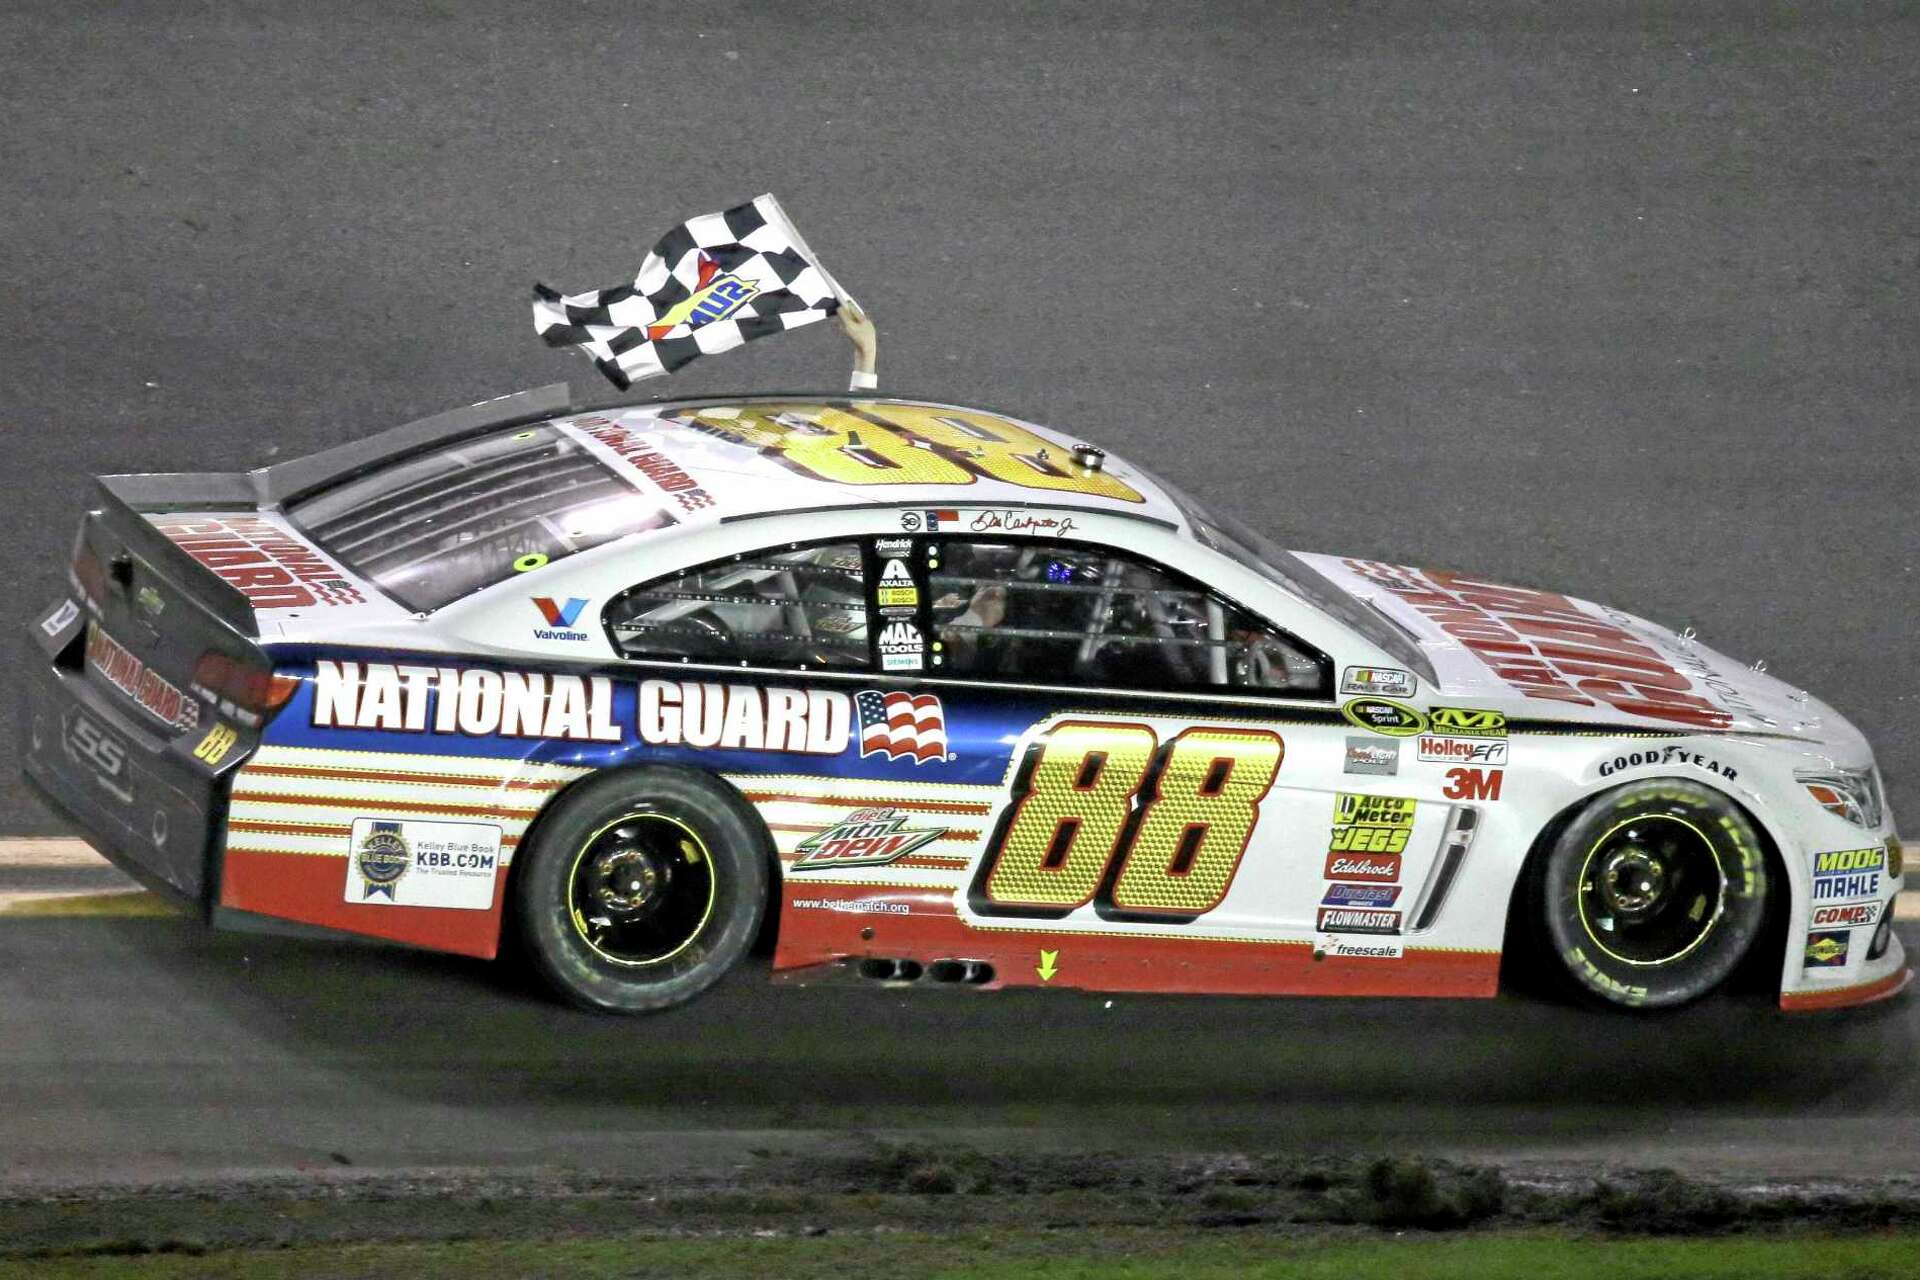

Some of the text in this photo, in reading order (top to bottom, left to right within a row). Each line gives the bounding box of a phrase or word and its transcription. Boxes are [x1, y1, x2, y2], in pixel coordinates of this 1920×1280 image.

[533, 629, 588, 641] Valvoline
[879, 622, 922, 645] MAC
[879, 644, 924, 654] TOOLS
[315, 660, 851, 754] NATIONAL GUARD
[1371, 714, 1400, 724] Sprint
[193, 722, 239, 766] 88
[1421, 738, 1475, 762] Holley
[1443, 767, 1504, 801] 3M
[985, 720, 1286, 915] 88
[1329, 826, 1412, 853] JEGS
[417, 852, 494, 869] KBB.COM
[1330, 858, 1394, 876] Edelbrock
[1818, 848, 1883, 872] MOOG
[1814, 874, 1878, 899] MAHLE
[793, 898, 910, 915] www.bethematch.org
[1814, 905, 1866, 924] COMP
[1321, 910, 1397, 930] FLOWMASTER
[1336, 943, 1397, 957] freescale
